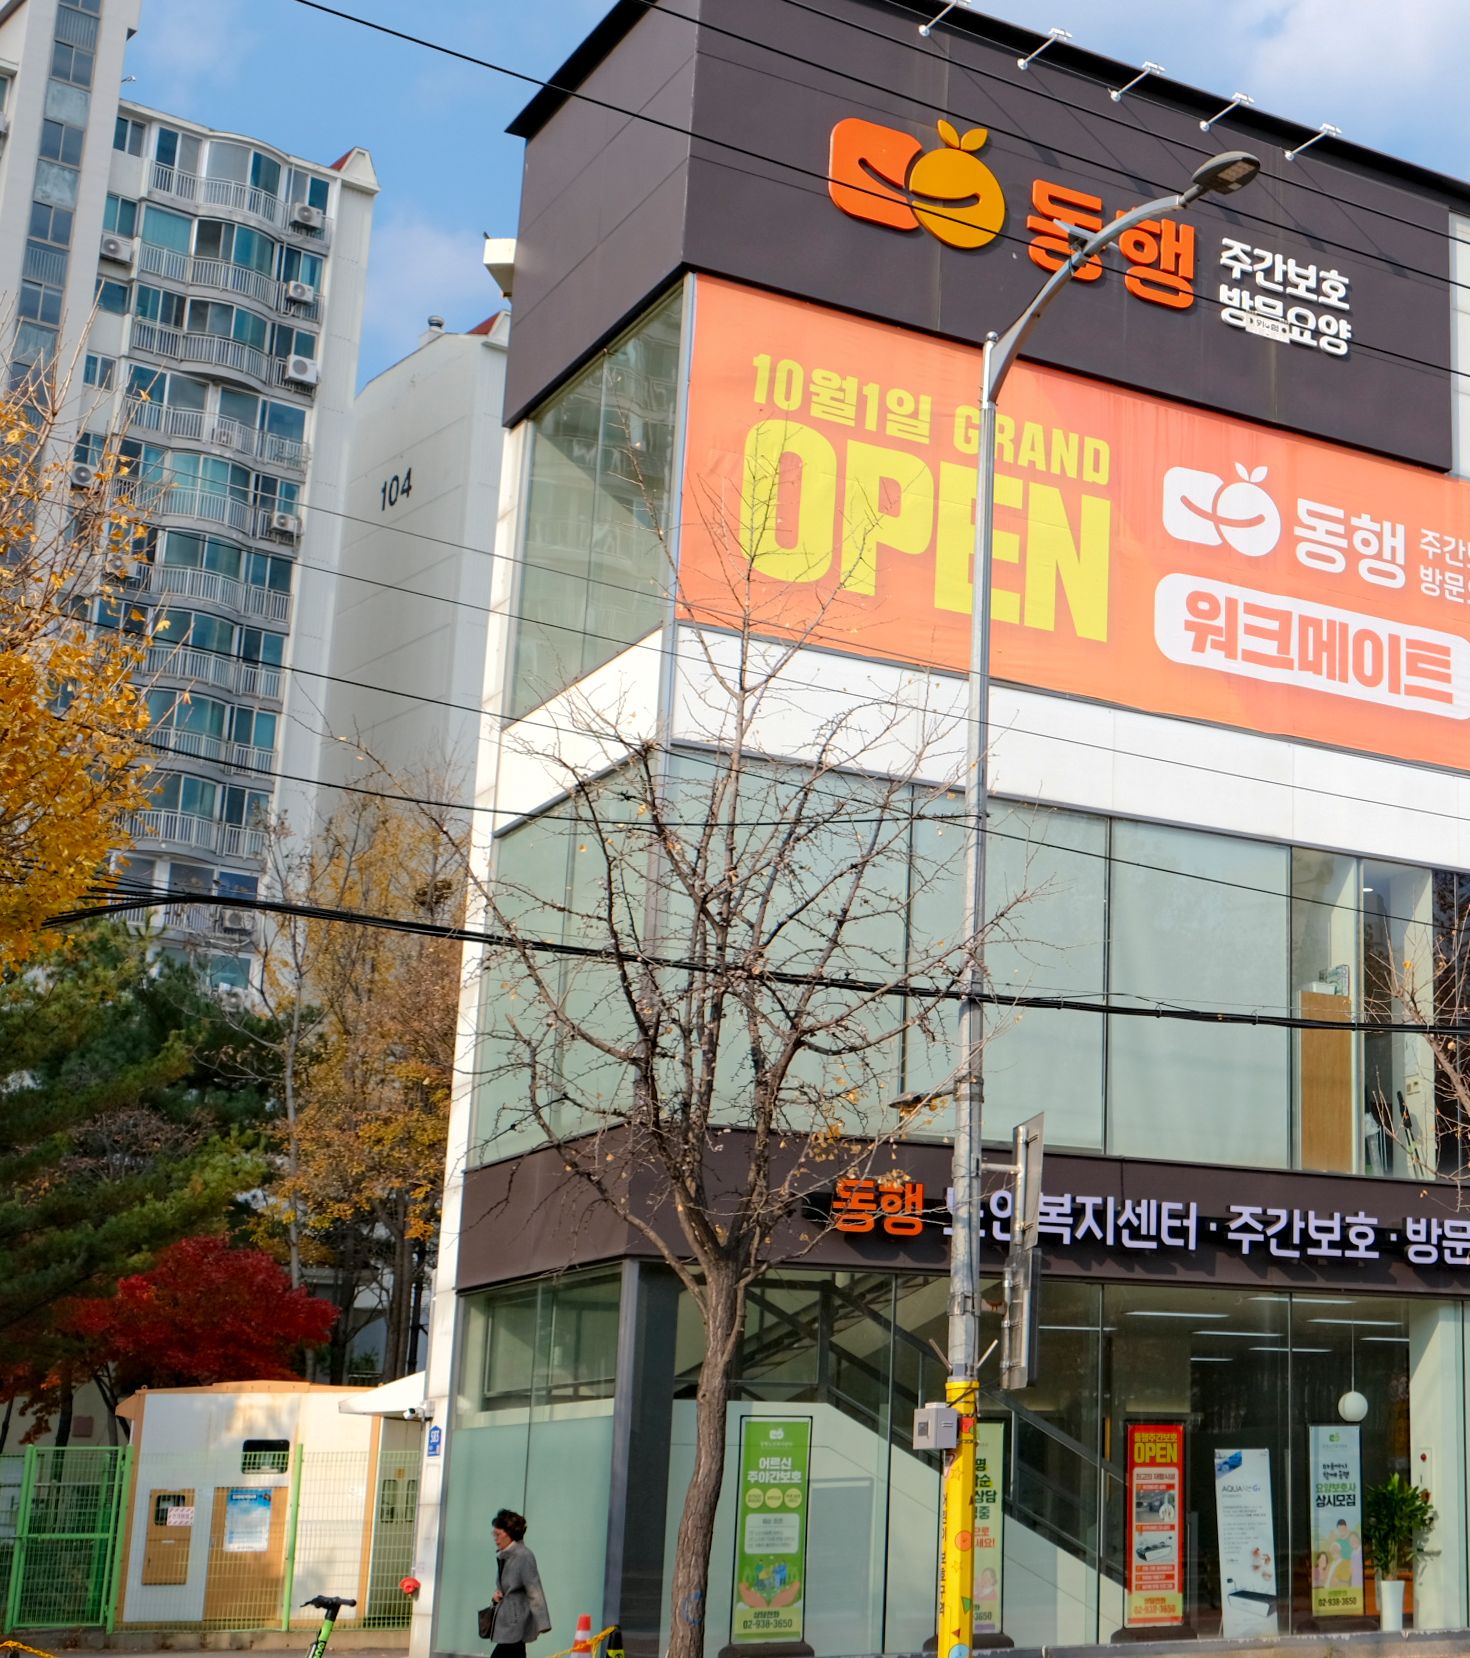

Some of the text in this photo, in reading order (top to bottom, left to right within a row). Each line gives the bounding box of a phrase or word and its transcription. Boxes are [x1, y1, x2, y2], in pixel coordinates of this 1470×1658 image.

[1027, 178, 1196, 310] 동행
[1220, 237, 1350, 311] 주간보호
[1219, 284, 1352, 356] 방문요양
[752, 353, 1111, 486] 10월1일 GRAND
[381, 467, 412, 512] 104
[739, 418, 1111, 643] OPEN
[1293, 498, 1406, 590] 동행
[1183, 590, 1454, 705] 워크메이트
[832, 1178, 925, 1237] 동행
[1227, 1204, 1379, 1259] 주간보호
[747, 1470, 802, 1484] 주야간보호
[759, 1456, 792, 1470] 어르신
[1134, 1442, 1178, 1464] OPEN
[1316, 1494, 1356, 1508] 상시모집
